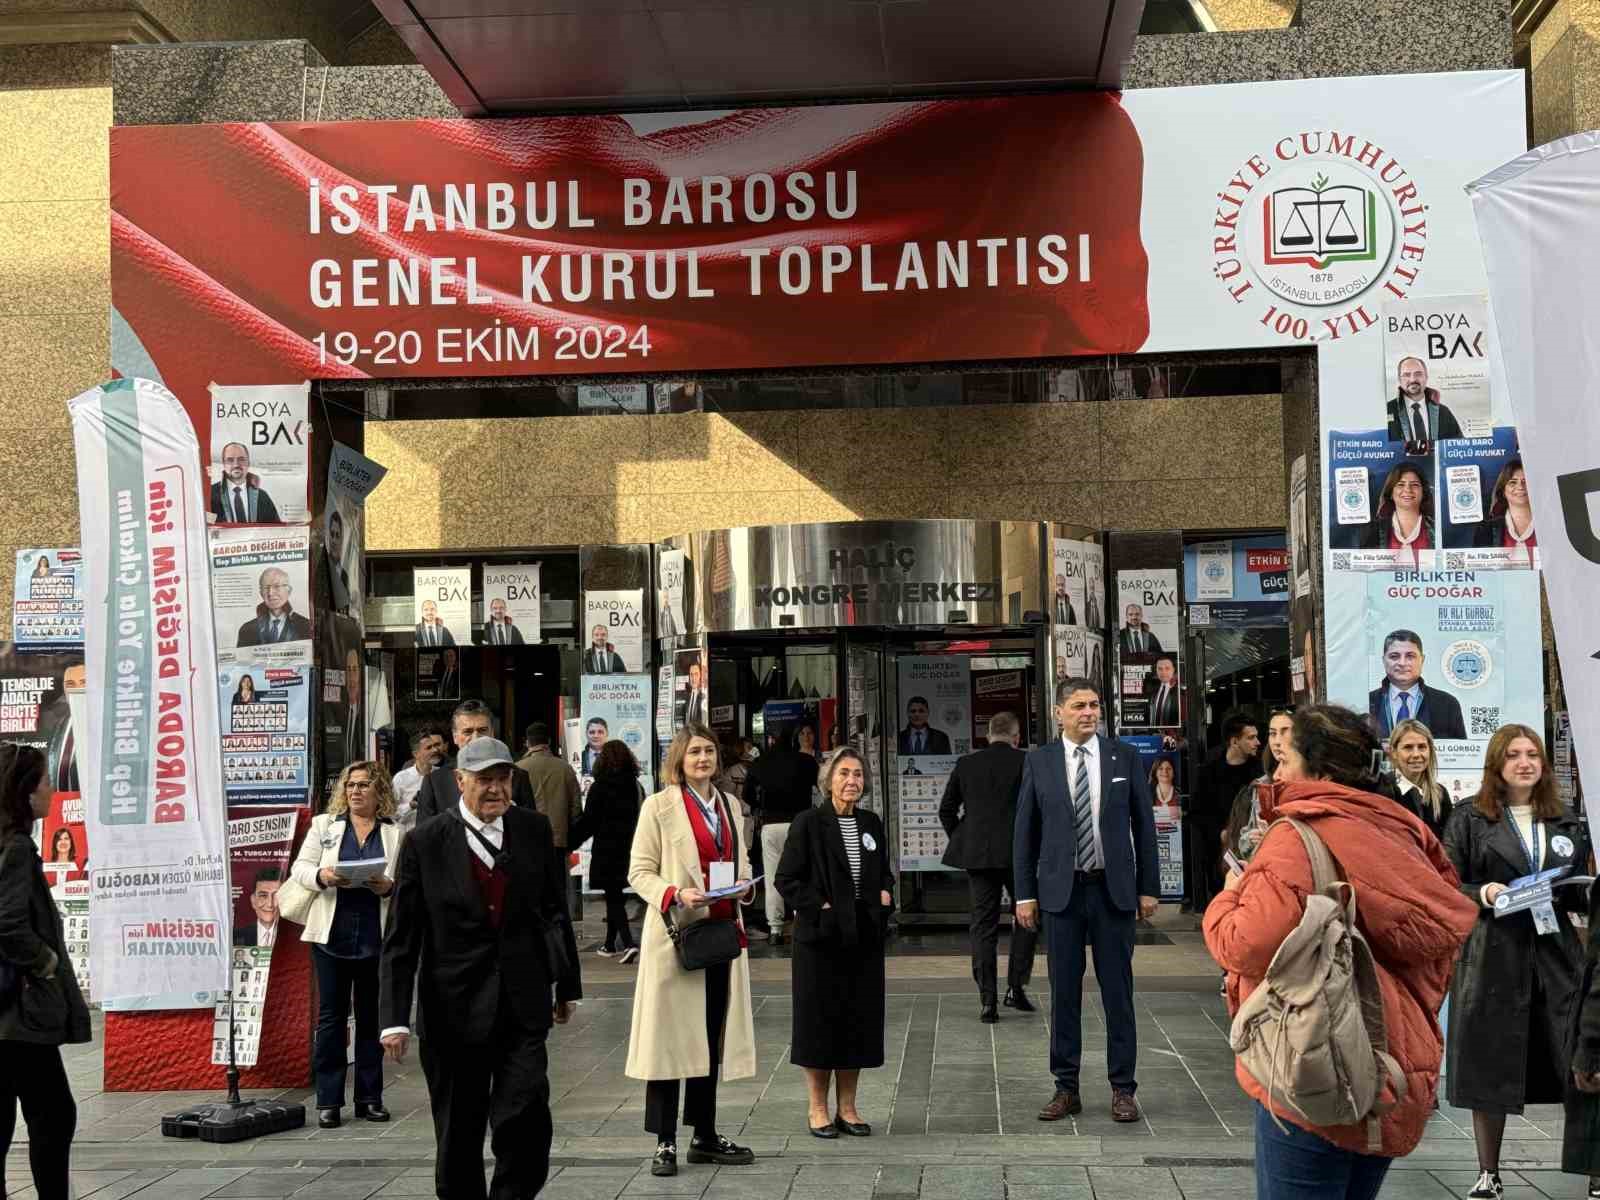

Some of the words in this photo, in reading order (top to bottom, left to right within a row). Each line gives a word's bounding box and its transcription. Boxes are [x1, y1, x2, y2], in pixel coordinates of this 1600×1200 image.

[309, 178, 594, 234] İSTANBUL
[624, 170, 858, 226] BAROSU
[1212, 154, 1271, 303] TÜRKİYE
[1275, 131, 1429, 300] CUMHURİYETİ
[309, 256, 492, 308] GENEL
[522, 250, 715, 302] KURUL
[741, 234, 1091, 296] TOPLANTISI
[1309, 274, 1334, 283] 1878
[1269, 276, 1322, 301] İSTANBUL
[1323, 275, 1369, 300] BAROSU
[1259, 305, 1316, 341] 100.
[1321, 304, 1380, 340] YIL
[1387, 313, 1471, 333] BAROYA
[312, 330, 422, 365] 19-20
[437, 319, 539, 363] EKİM
[555, 324, 652, 360] 2024
[216, 402, 292, 418] BAROYA
[1336, 440, 1361, 448] ETKİN
[1361, 440, 1383, 448] BARO
[1471, 438, 1493, 446] BARO
[1363, 451, 1395, 459] AVUKAT
[1474, 448, 1506, 458] AVUKAT
[828, 542, 915, 573] HALİÇ
[1055, 549, 1081, 560] AROYA
[1249, 554, 1281, 566] ETKİN
[417, 575, 462, 586] BAROYA
[486, 574, 531, 585] BAROYA
[1121, 580, 1168, 590] BAROYA
[755, 583, 869, 607] KONGRE
[1387, 584, 1421, 600] GÜÇ
[1425, 583, 1483, 599] DOĞAR
[588, 600, 633, 611] BAROYA
[1, 677, 55, 691] TEMSİLDE
[1, 691, 43, 705] ADALET
[252, 815, 291, 833] SENSİN!
[230, 834, 256, 845] BARO
